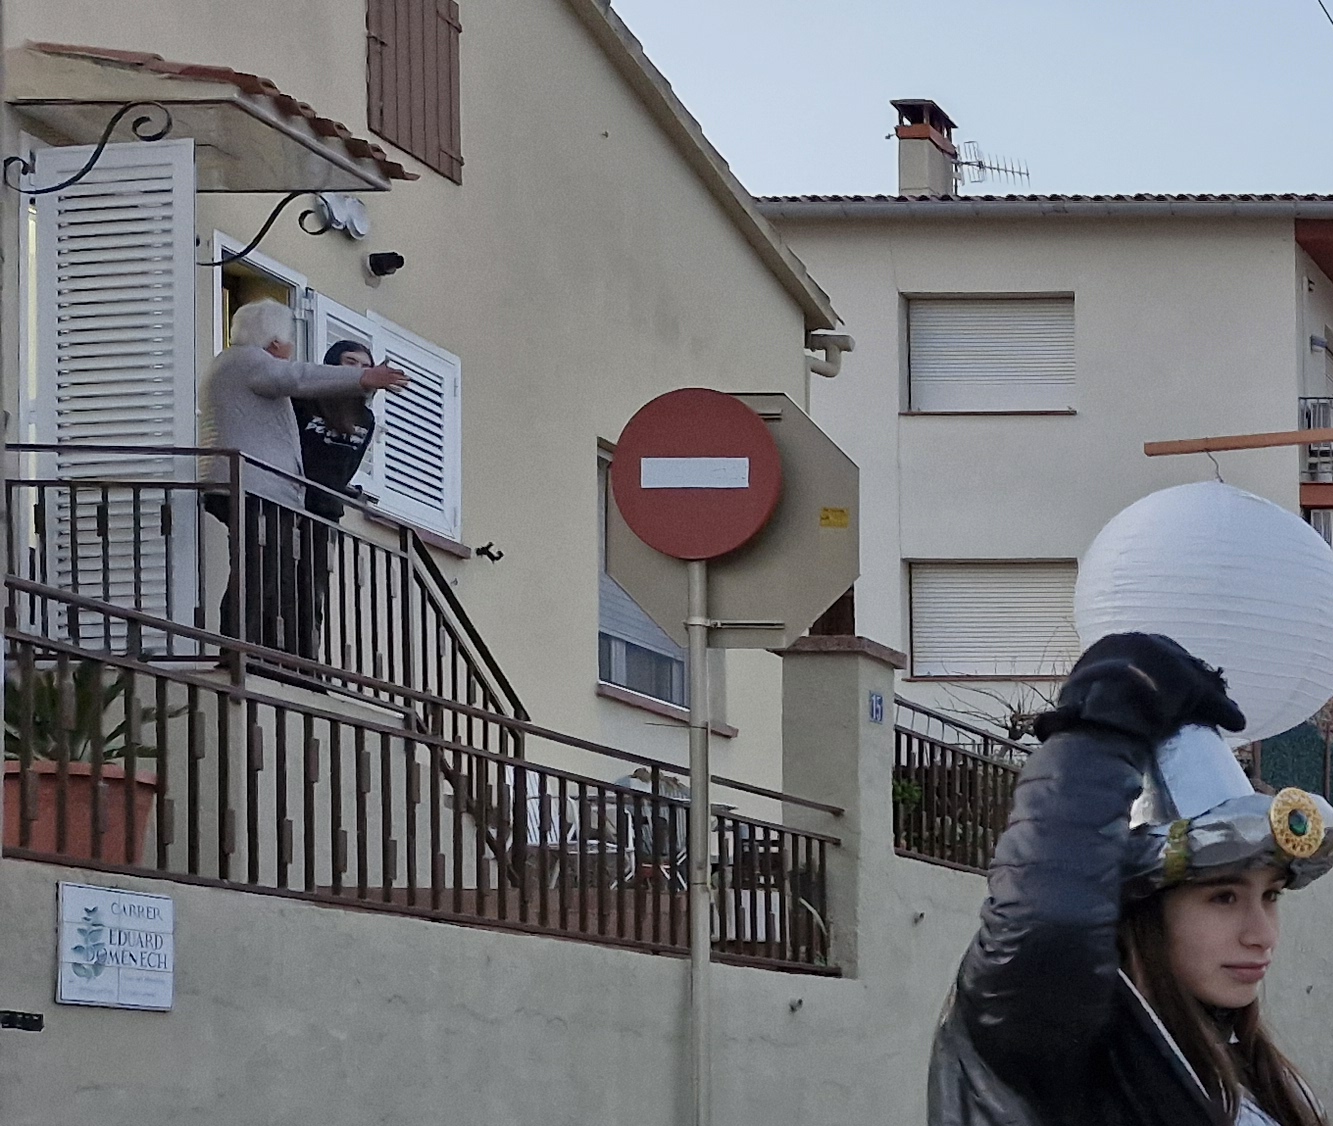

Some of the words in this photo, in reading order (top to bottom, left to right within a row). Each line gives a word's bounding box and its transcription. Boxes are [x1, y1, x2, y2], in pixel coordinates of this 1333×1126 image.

[871, 694, 882, 721] 15
[110, 902, 163, 921] CARRER
[109, 928, 163, 950] EDUARD
